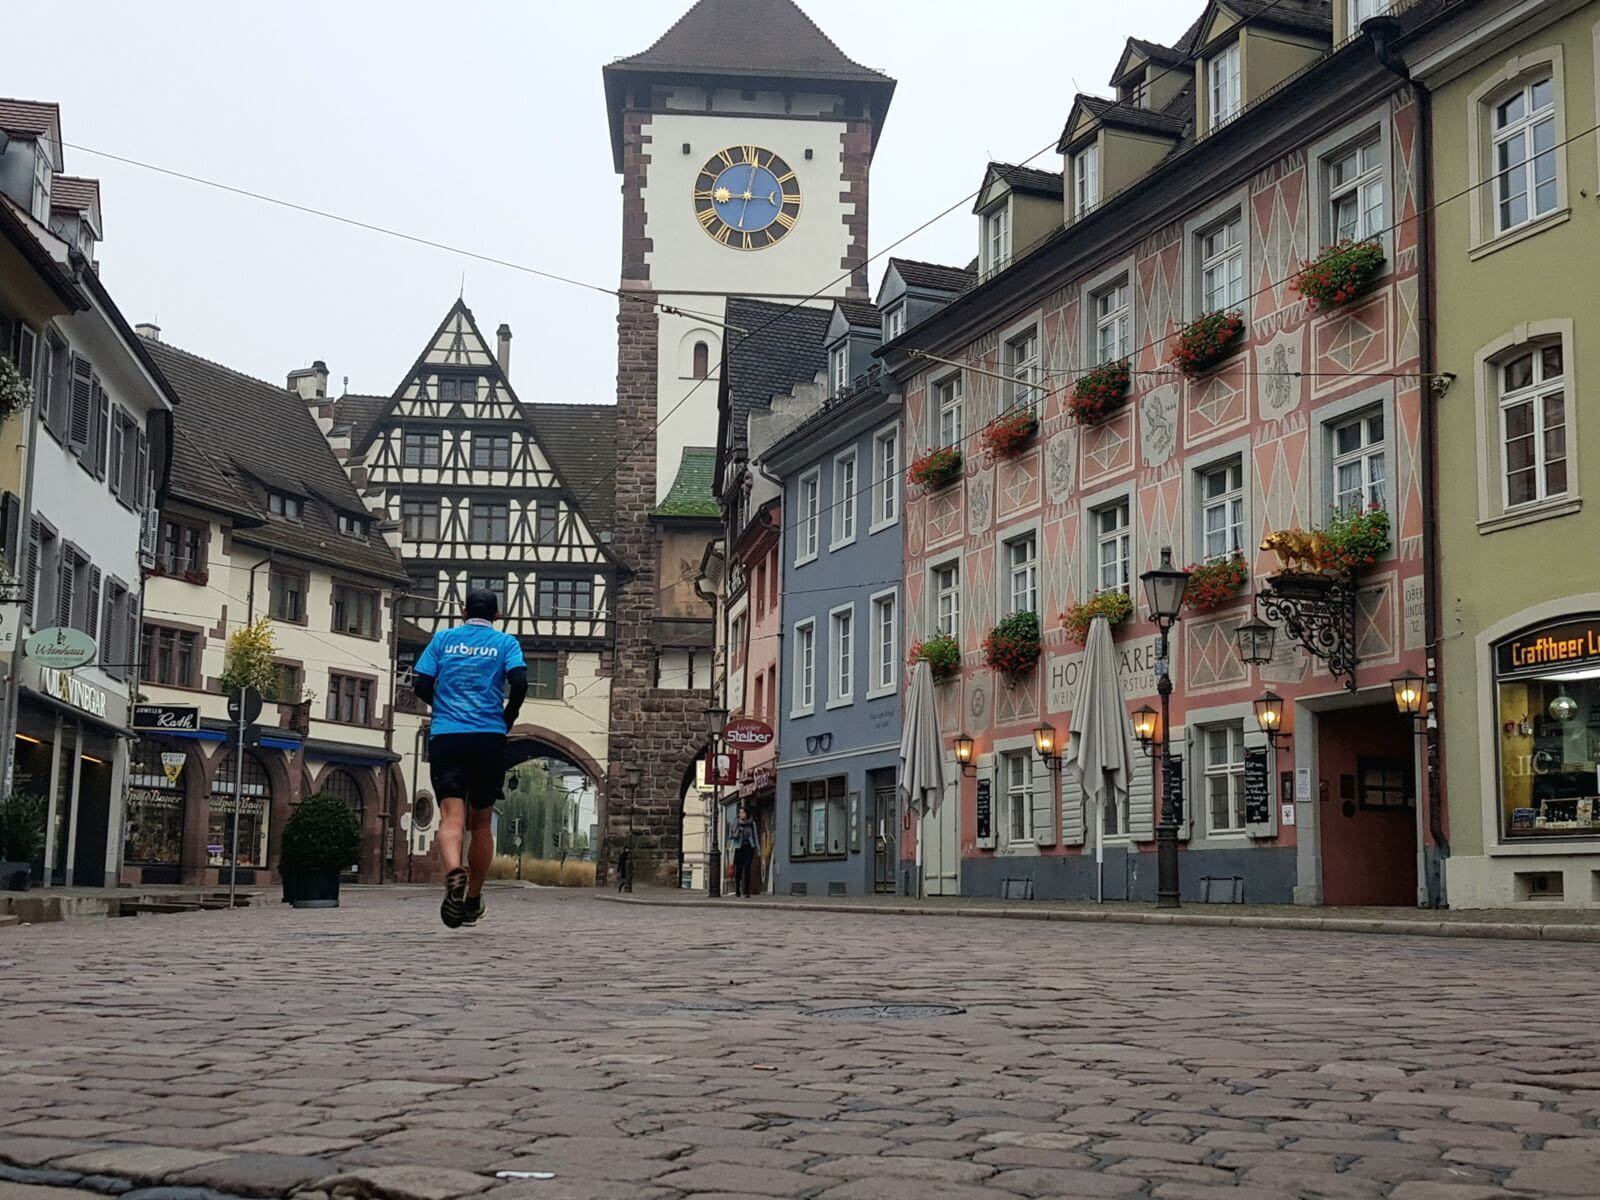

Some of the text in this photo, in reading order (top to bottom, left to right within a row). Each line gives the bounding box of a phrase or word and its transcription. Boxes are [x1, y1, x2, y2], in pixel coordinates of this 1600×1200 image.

[35, 643, 85, 656] Weinhaus
[1118, 644, 1154, 676] ÄRE
[1512, 636, 1584, 667] Craftbeer
[1121, 675, 1158, 694] RSTUB
[67, 676, 106, 719] VINEGAR
[157, 712, 194, 729] Rath
